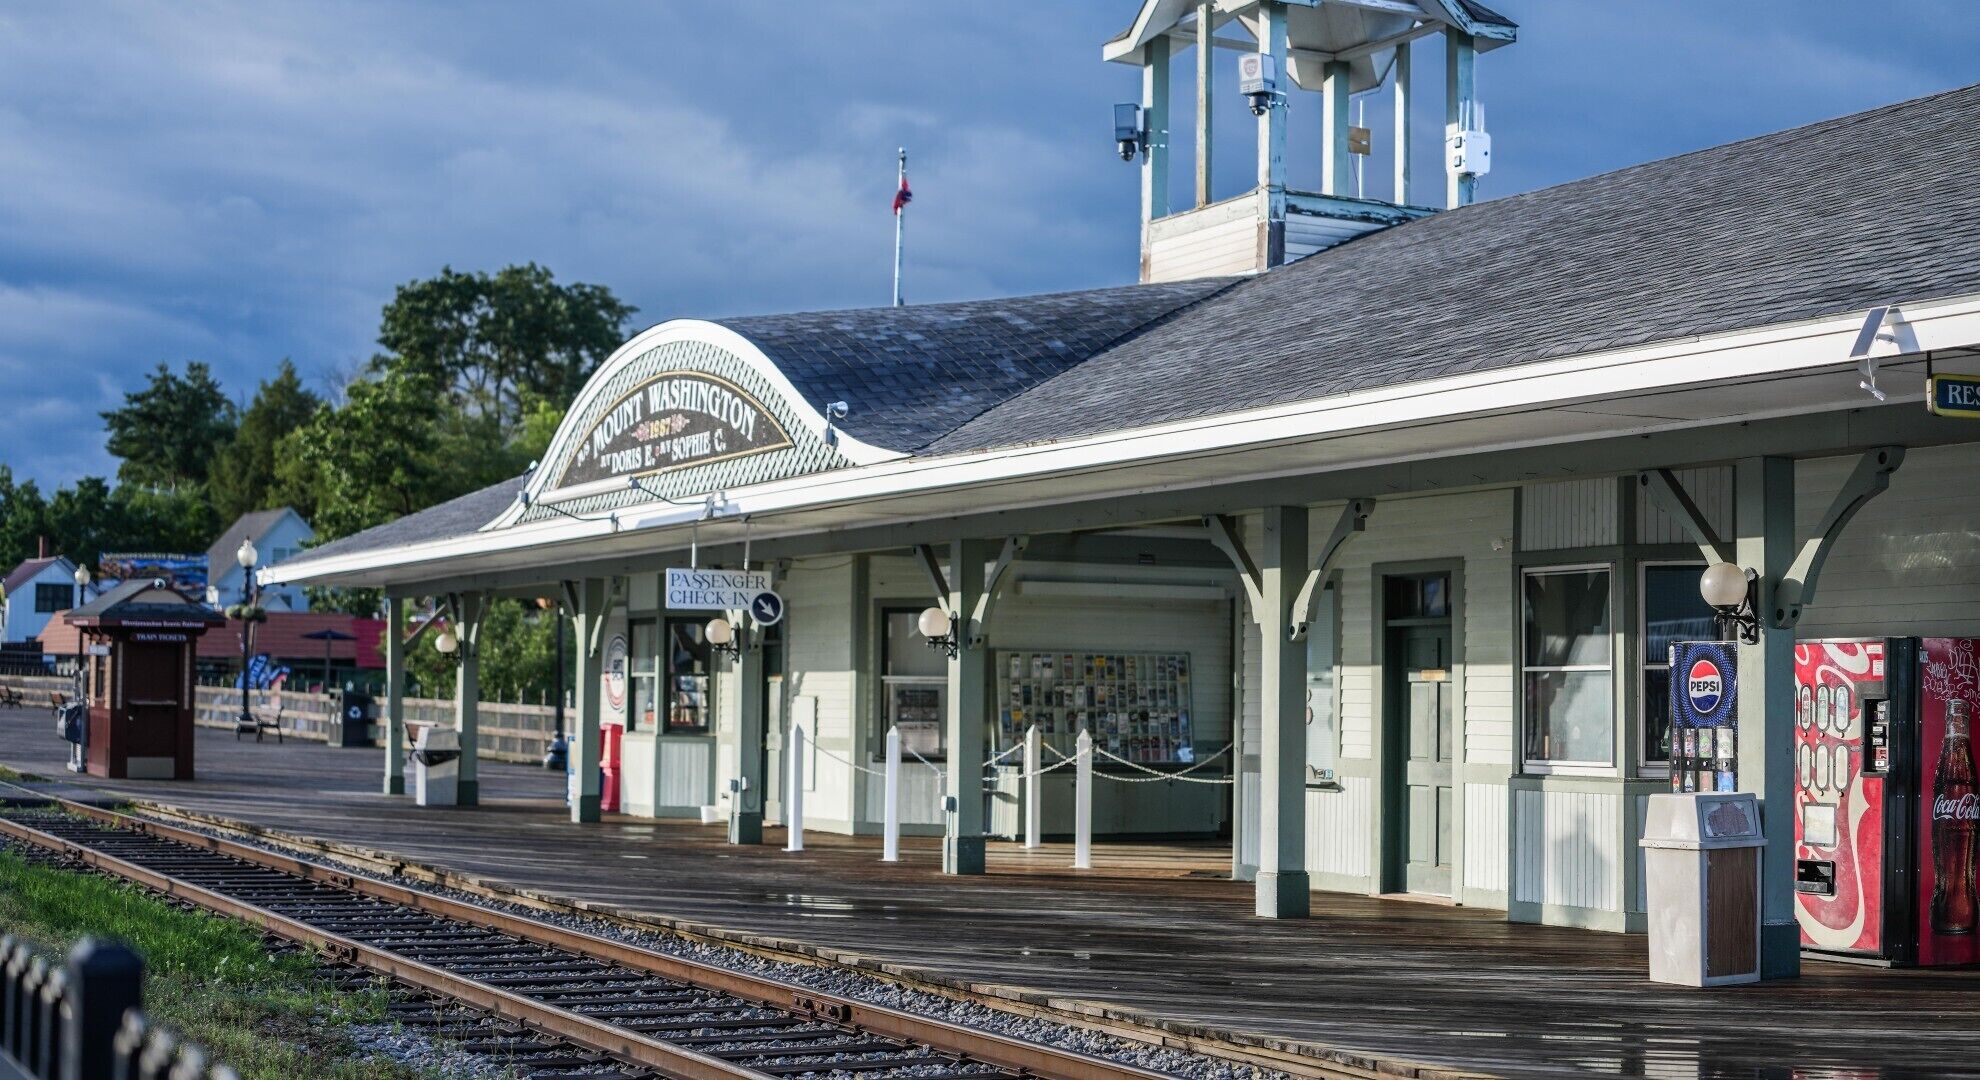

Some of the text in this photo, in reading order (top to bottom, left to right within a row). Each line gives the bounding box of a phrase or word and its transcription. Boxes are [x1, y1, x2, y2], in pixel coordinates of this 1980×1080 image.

[593, 390, 643, 460] MOUNT
[648, 379, 757, 442] WASHINGTON
[611, 446, 642, 474] DORIS
[671, 430, 712, 461] SOPHIE
[671, 573, 766, 590] PASSENGER
[670, 590, 749, 606] CHECK-IN
[1690, 680, 1720, 693] PEPSI
[1933, 793, 1980, 820] Coca-Cola
